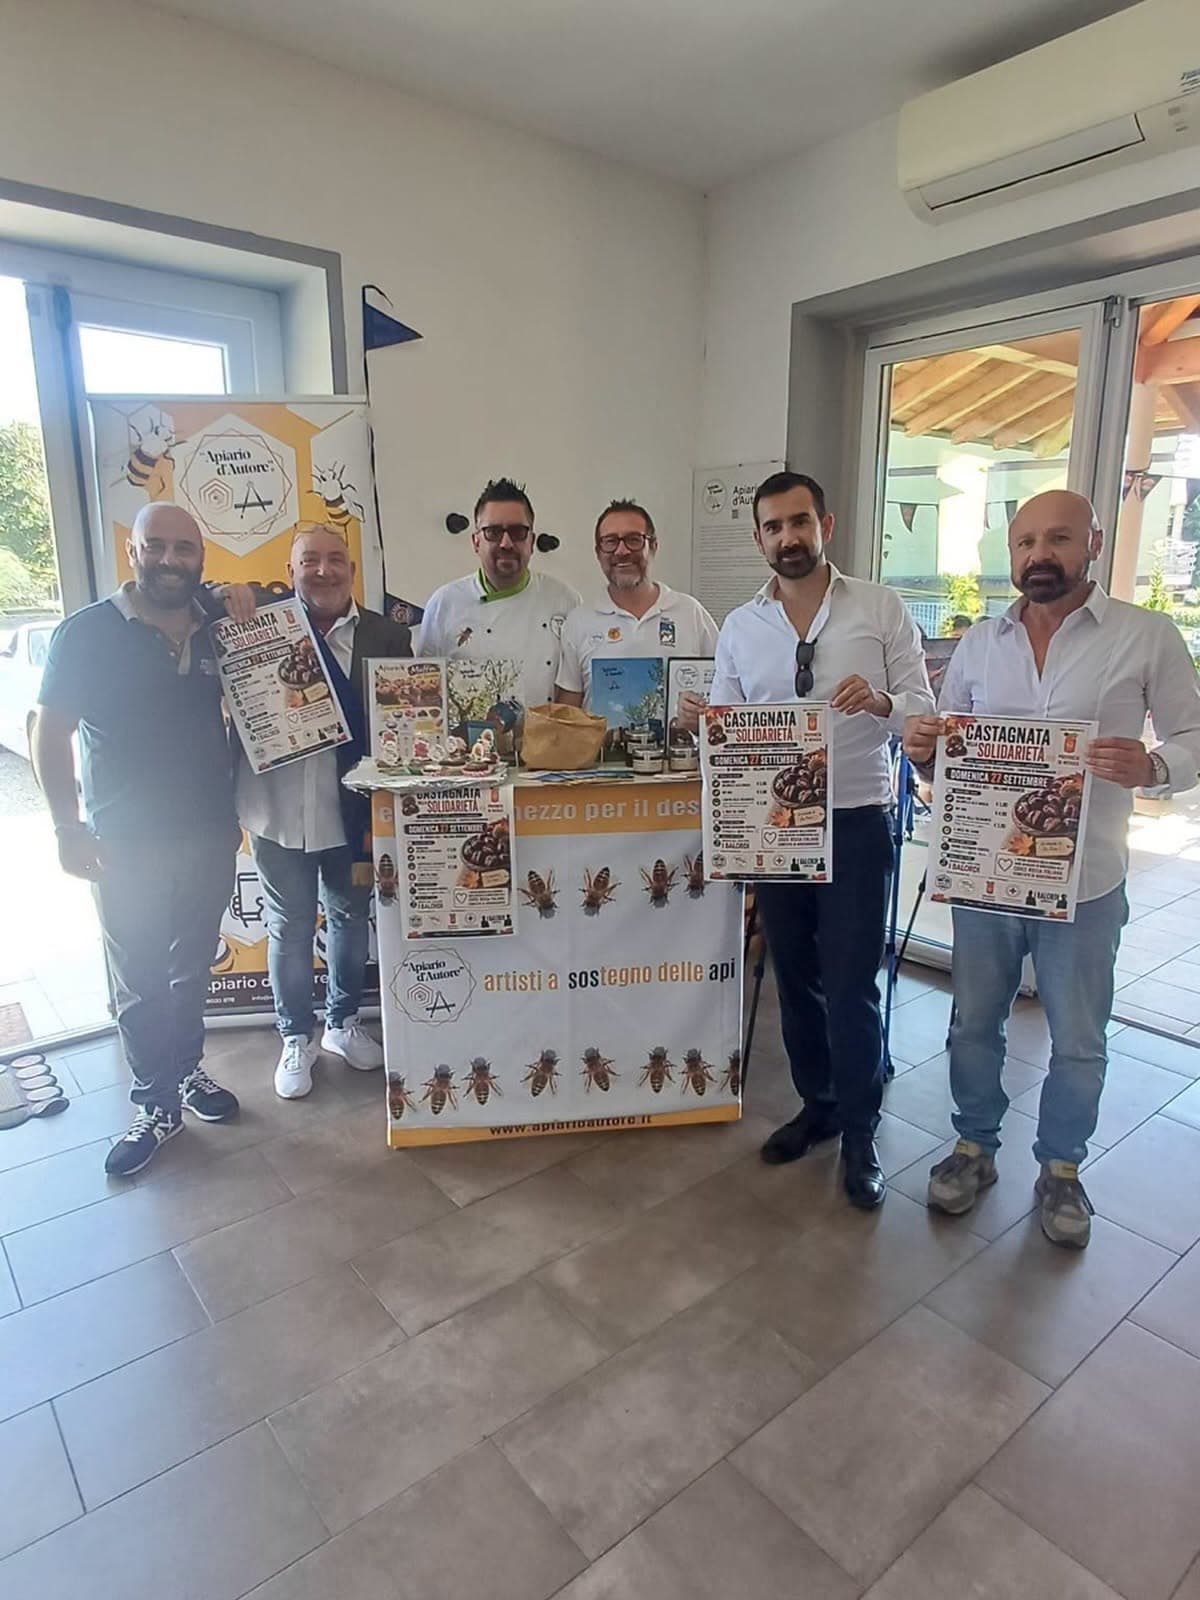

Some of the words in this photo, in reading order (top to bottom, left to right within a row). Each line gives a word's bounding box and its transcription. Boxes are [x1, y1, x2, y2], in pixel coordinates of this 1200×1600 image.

[733, 485, 759, 496] Apiari
[732, 496, 755, 505] d'Aut
[218, 612, 279, 641] CASTAGNATA
[724, 711, 797, 728] CASTAGNATA
[965, 724, 1051, 746] CASTAGNATA
[761, 754, 799, 764] SETTEMBRE
[976, 742, 1045, 762] SOLIDARIETÀ
[950, 769, 989, 782] DOMENICA
[1003, 774, 1049, 788] SETTEMBRE
[585, 801, 626, 822] per
[633, 798, 649, 817] il
[484, 970, 542, 991] artisti
[548, 973, 559, 990] a
[568, 964, 652, 990] sostegno
[658, 961, 704, 983] delle
[709, 957, 736, 983] api
[207, 975, 258, 993] piario
